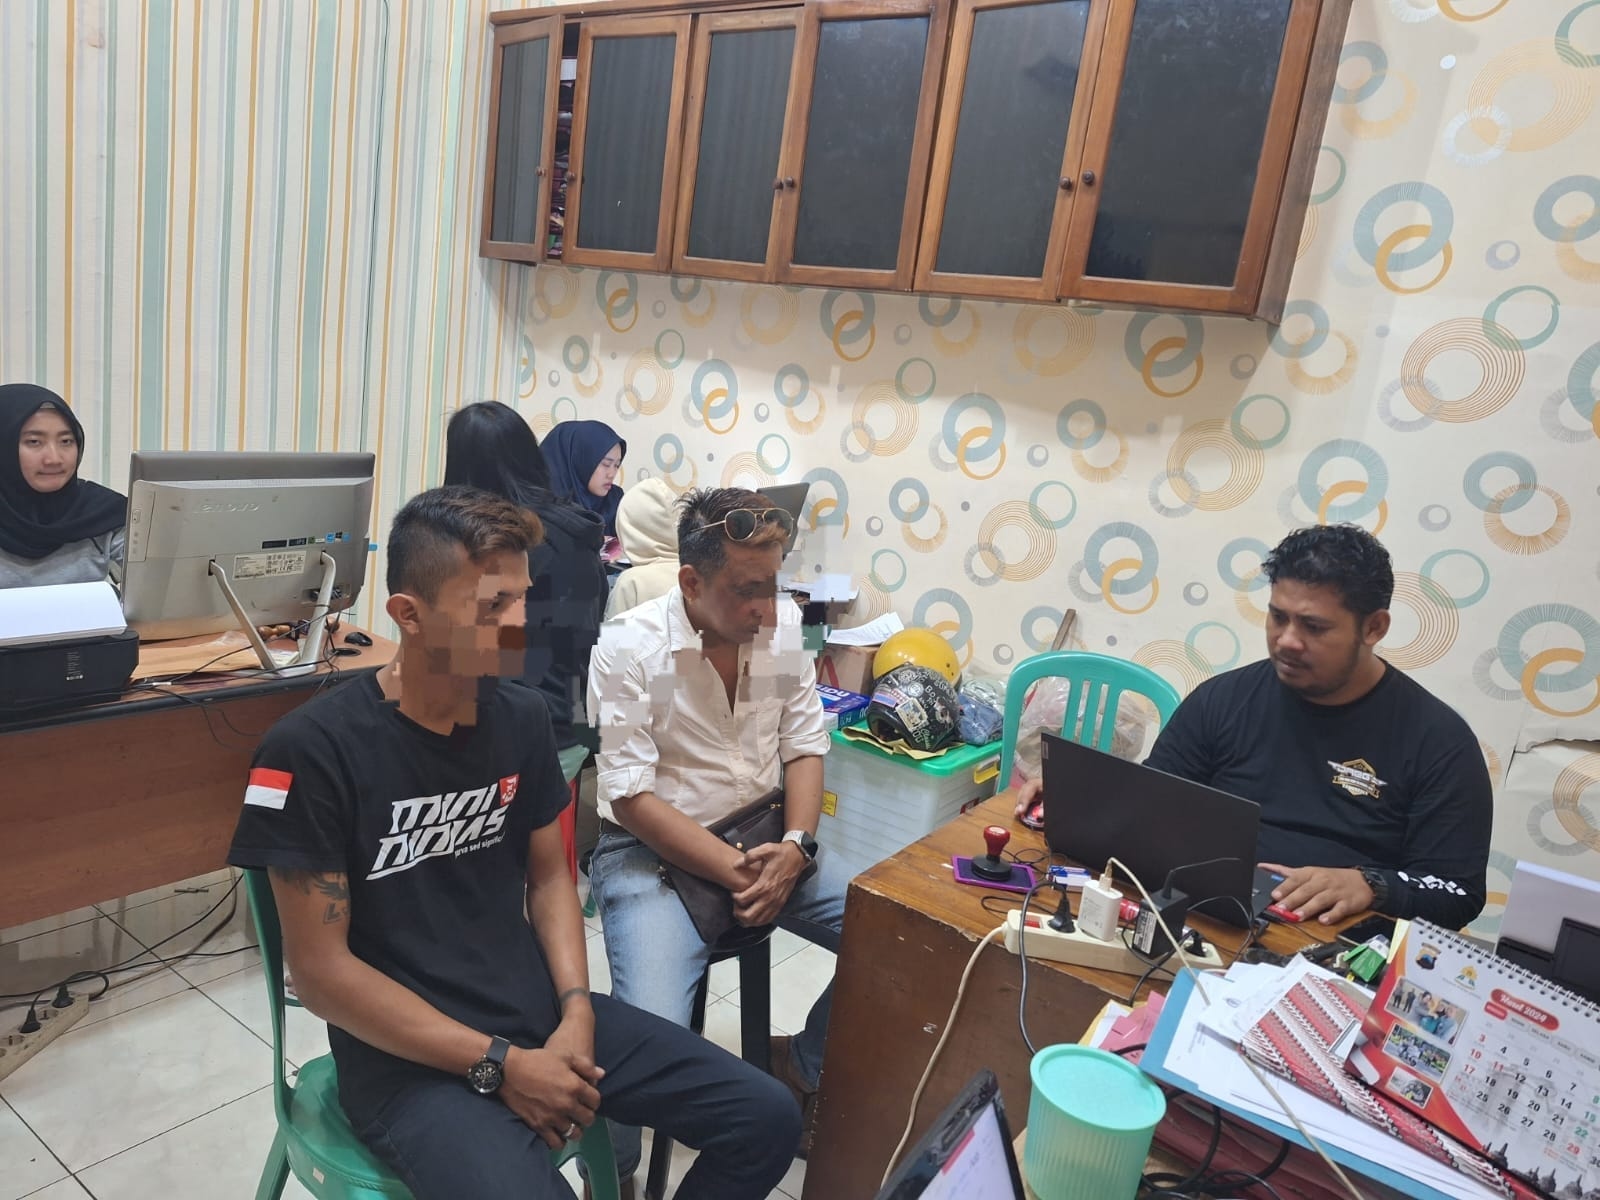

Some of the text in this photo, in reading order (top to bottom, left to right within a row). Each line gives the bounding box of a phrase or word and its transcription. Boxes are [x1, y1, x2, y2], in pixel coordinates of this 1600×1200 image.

[1523, 1006, 1548, 1023] 2024
[1470, 1048, 1597, 1123] 10 11 12 13 14 15
[1479, 1034, 1486, 1042] 3
[1500, 1046, 1508, 1054] 4
[1523, 1058, 1530, 1066] 5
[1546, 1070, 1552, 1079] 6
[1569, 1082, 1577, 1091] 7
[1463, 1064, 1589, 1138] 17 18 19 20 21 22
[1476, 1091, 1489, 1103] 25
[1498, 1103, 1511, 1115] 26
[1520, 1116, 1534, 1128] 27
[1542, 1129, 1556, 1142] 28
[1566, 1142, 1581, 1155] 29
